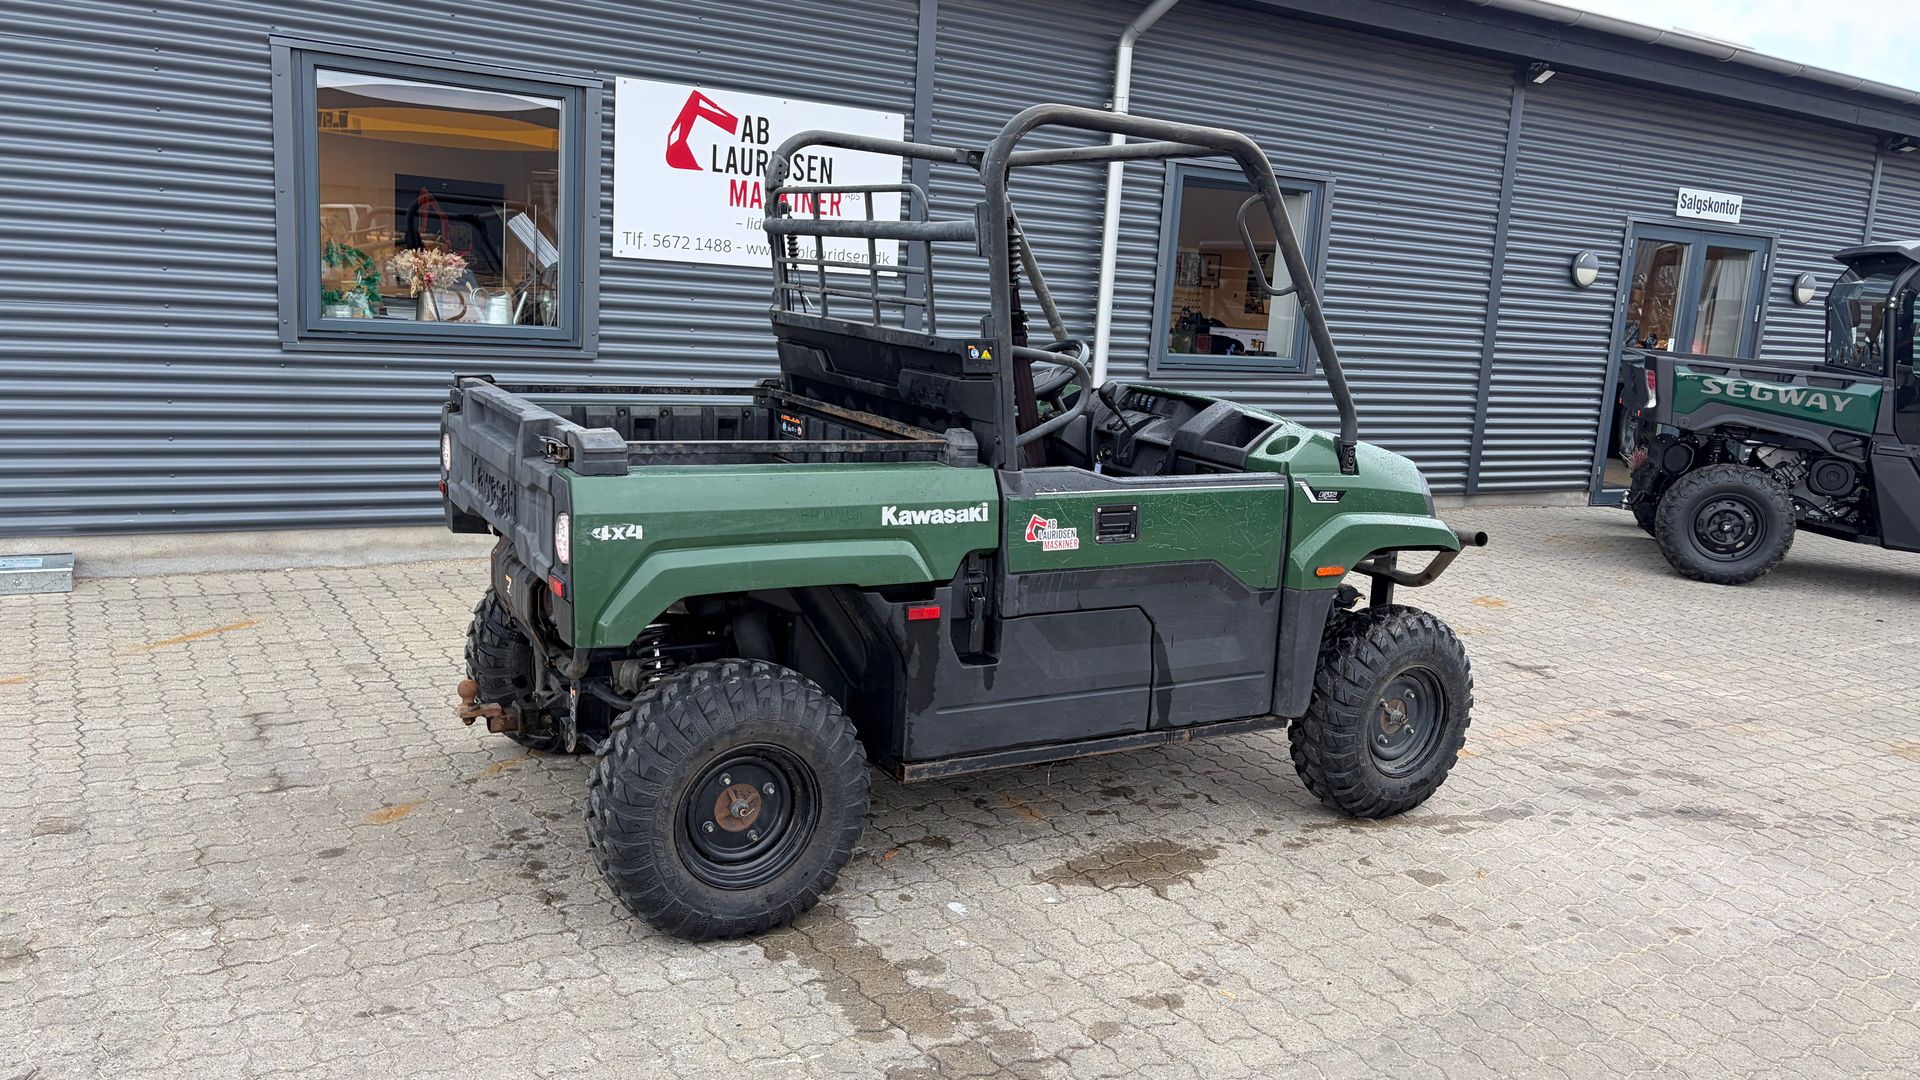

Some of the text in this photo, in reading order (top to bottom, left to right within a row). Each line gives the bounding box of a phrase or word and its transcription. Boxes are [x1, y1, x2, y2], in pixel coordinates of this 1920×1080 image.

[741, 115, 769, 144] AB
[712, 144, 833, 184] LAURSEN
[1680, 193, 1740, 215] Salgskontor
[622, 232, 647, 250] Tlf.
[653, 234, 690, 250] 5672
[695, 237, 732, 253] 1488
[1700, 378, 1854, 412] SEGWAY
[881, 502, 989, 525] Kawasaki
[1047, 519, 1057, 529] AB
[591, 524, 643, 541] 4x4
[1038, 529, 1076, 541] LAURIDSEN
[1043, 539, 1078, 550] MASKINER
